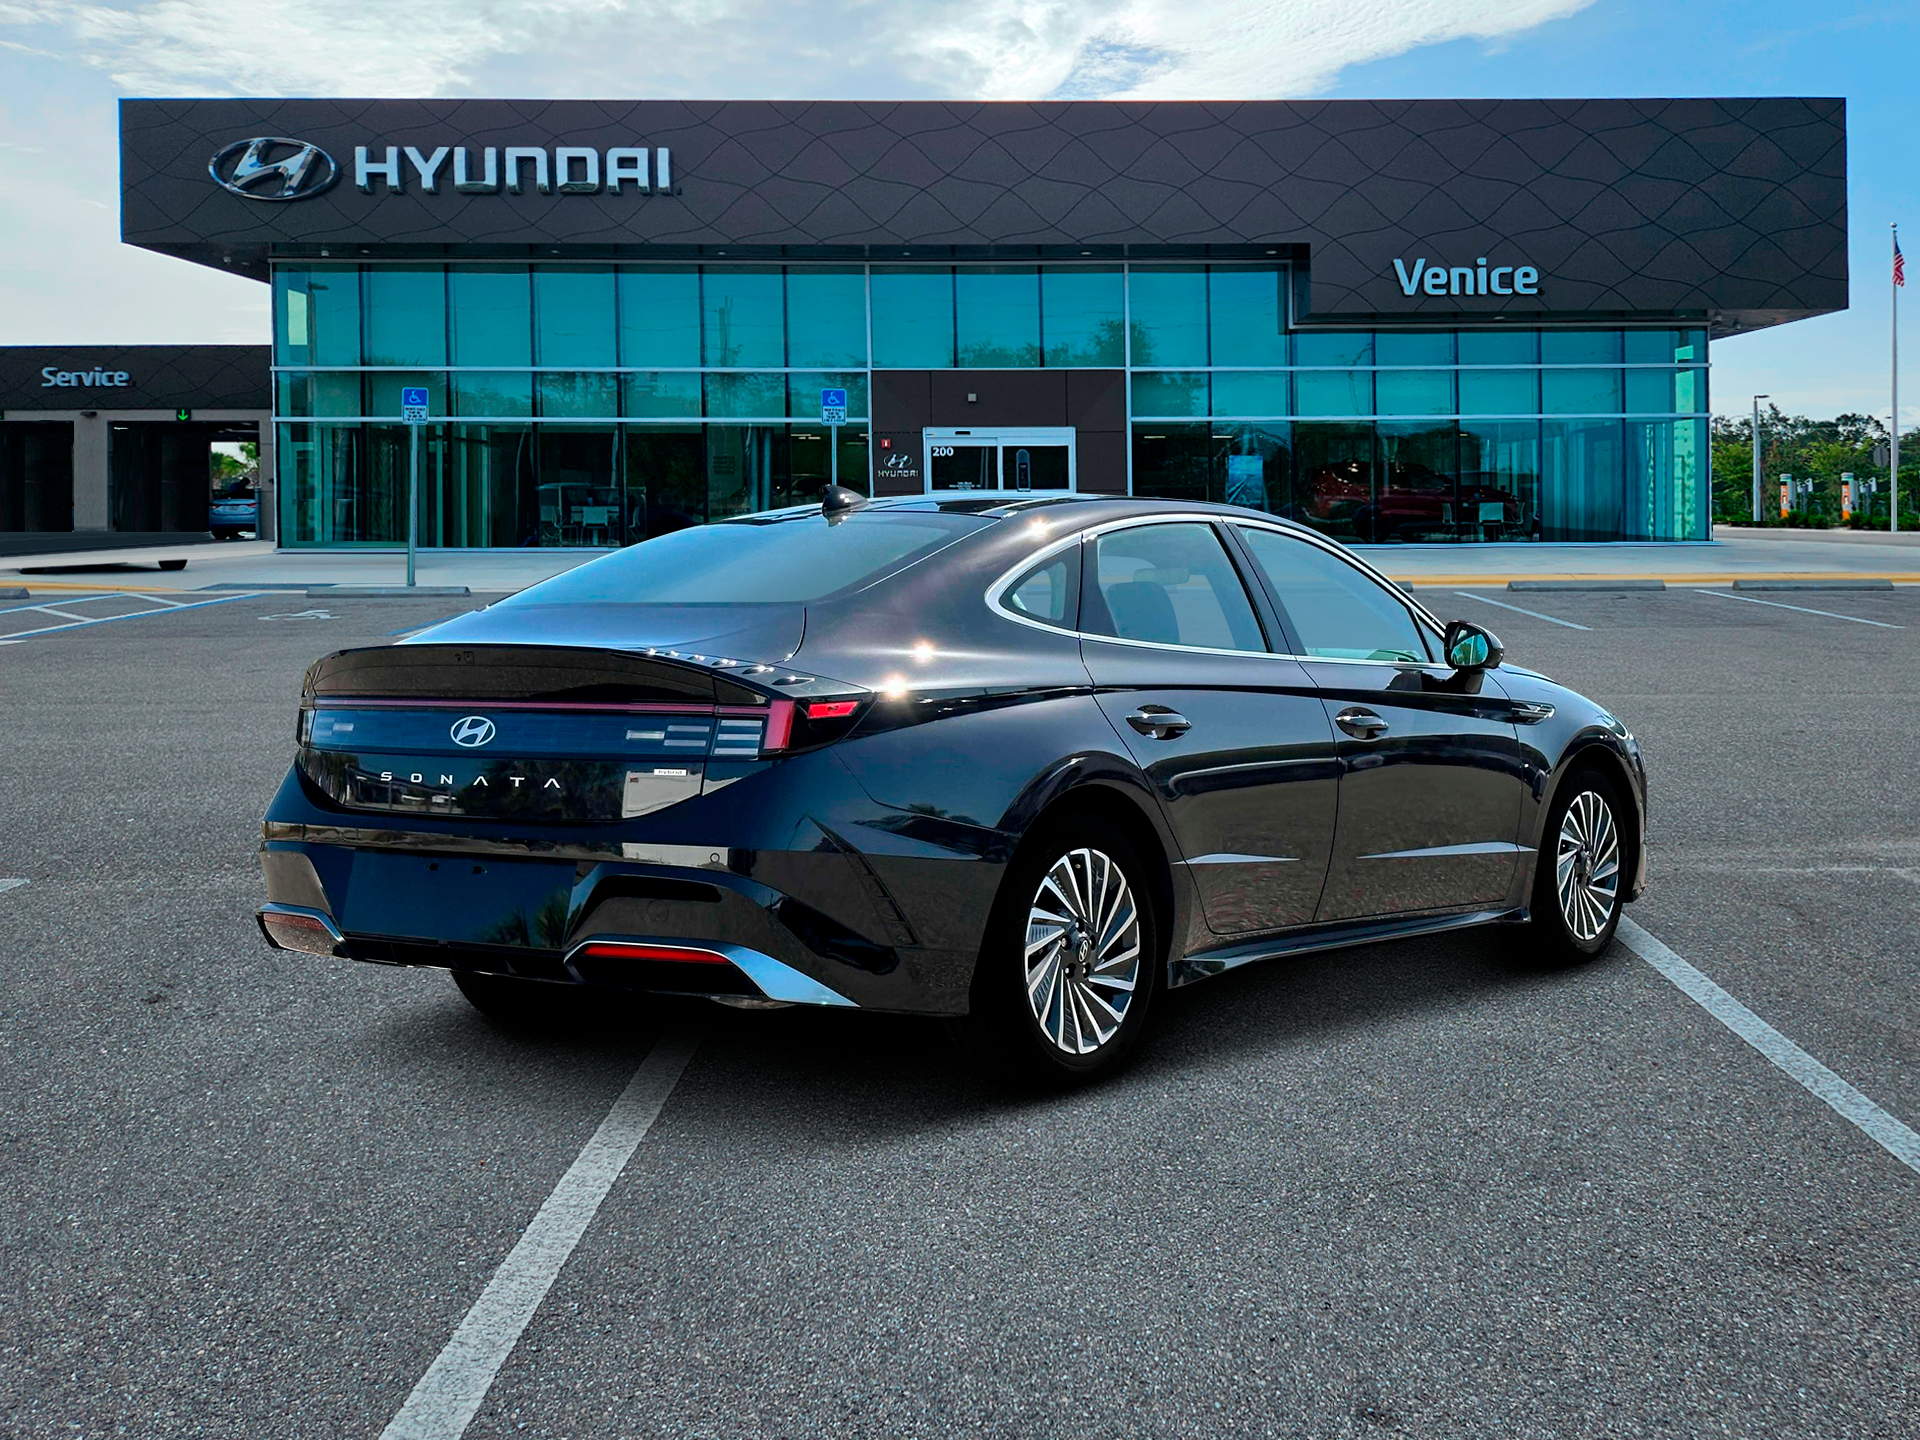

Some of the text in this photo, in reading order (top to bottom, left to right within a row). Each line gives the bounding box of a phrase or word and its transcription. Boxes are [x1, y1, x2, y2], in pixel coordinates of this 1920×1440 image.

[354, 145, 672, 196] HYUNDAI
[1392, 257, 1539, 296] Venice
[41, 366, 130, 387] Service
[932, 446, 954, 457] 200
[877, 469, 919, 478] HYUNDAI
[380, 771, 561, 789] SONATA
